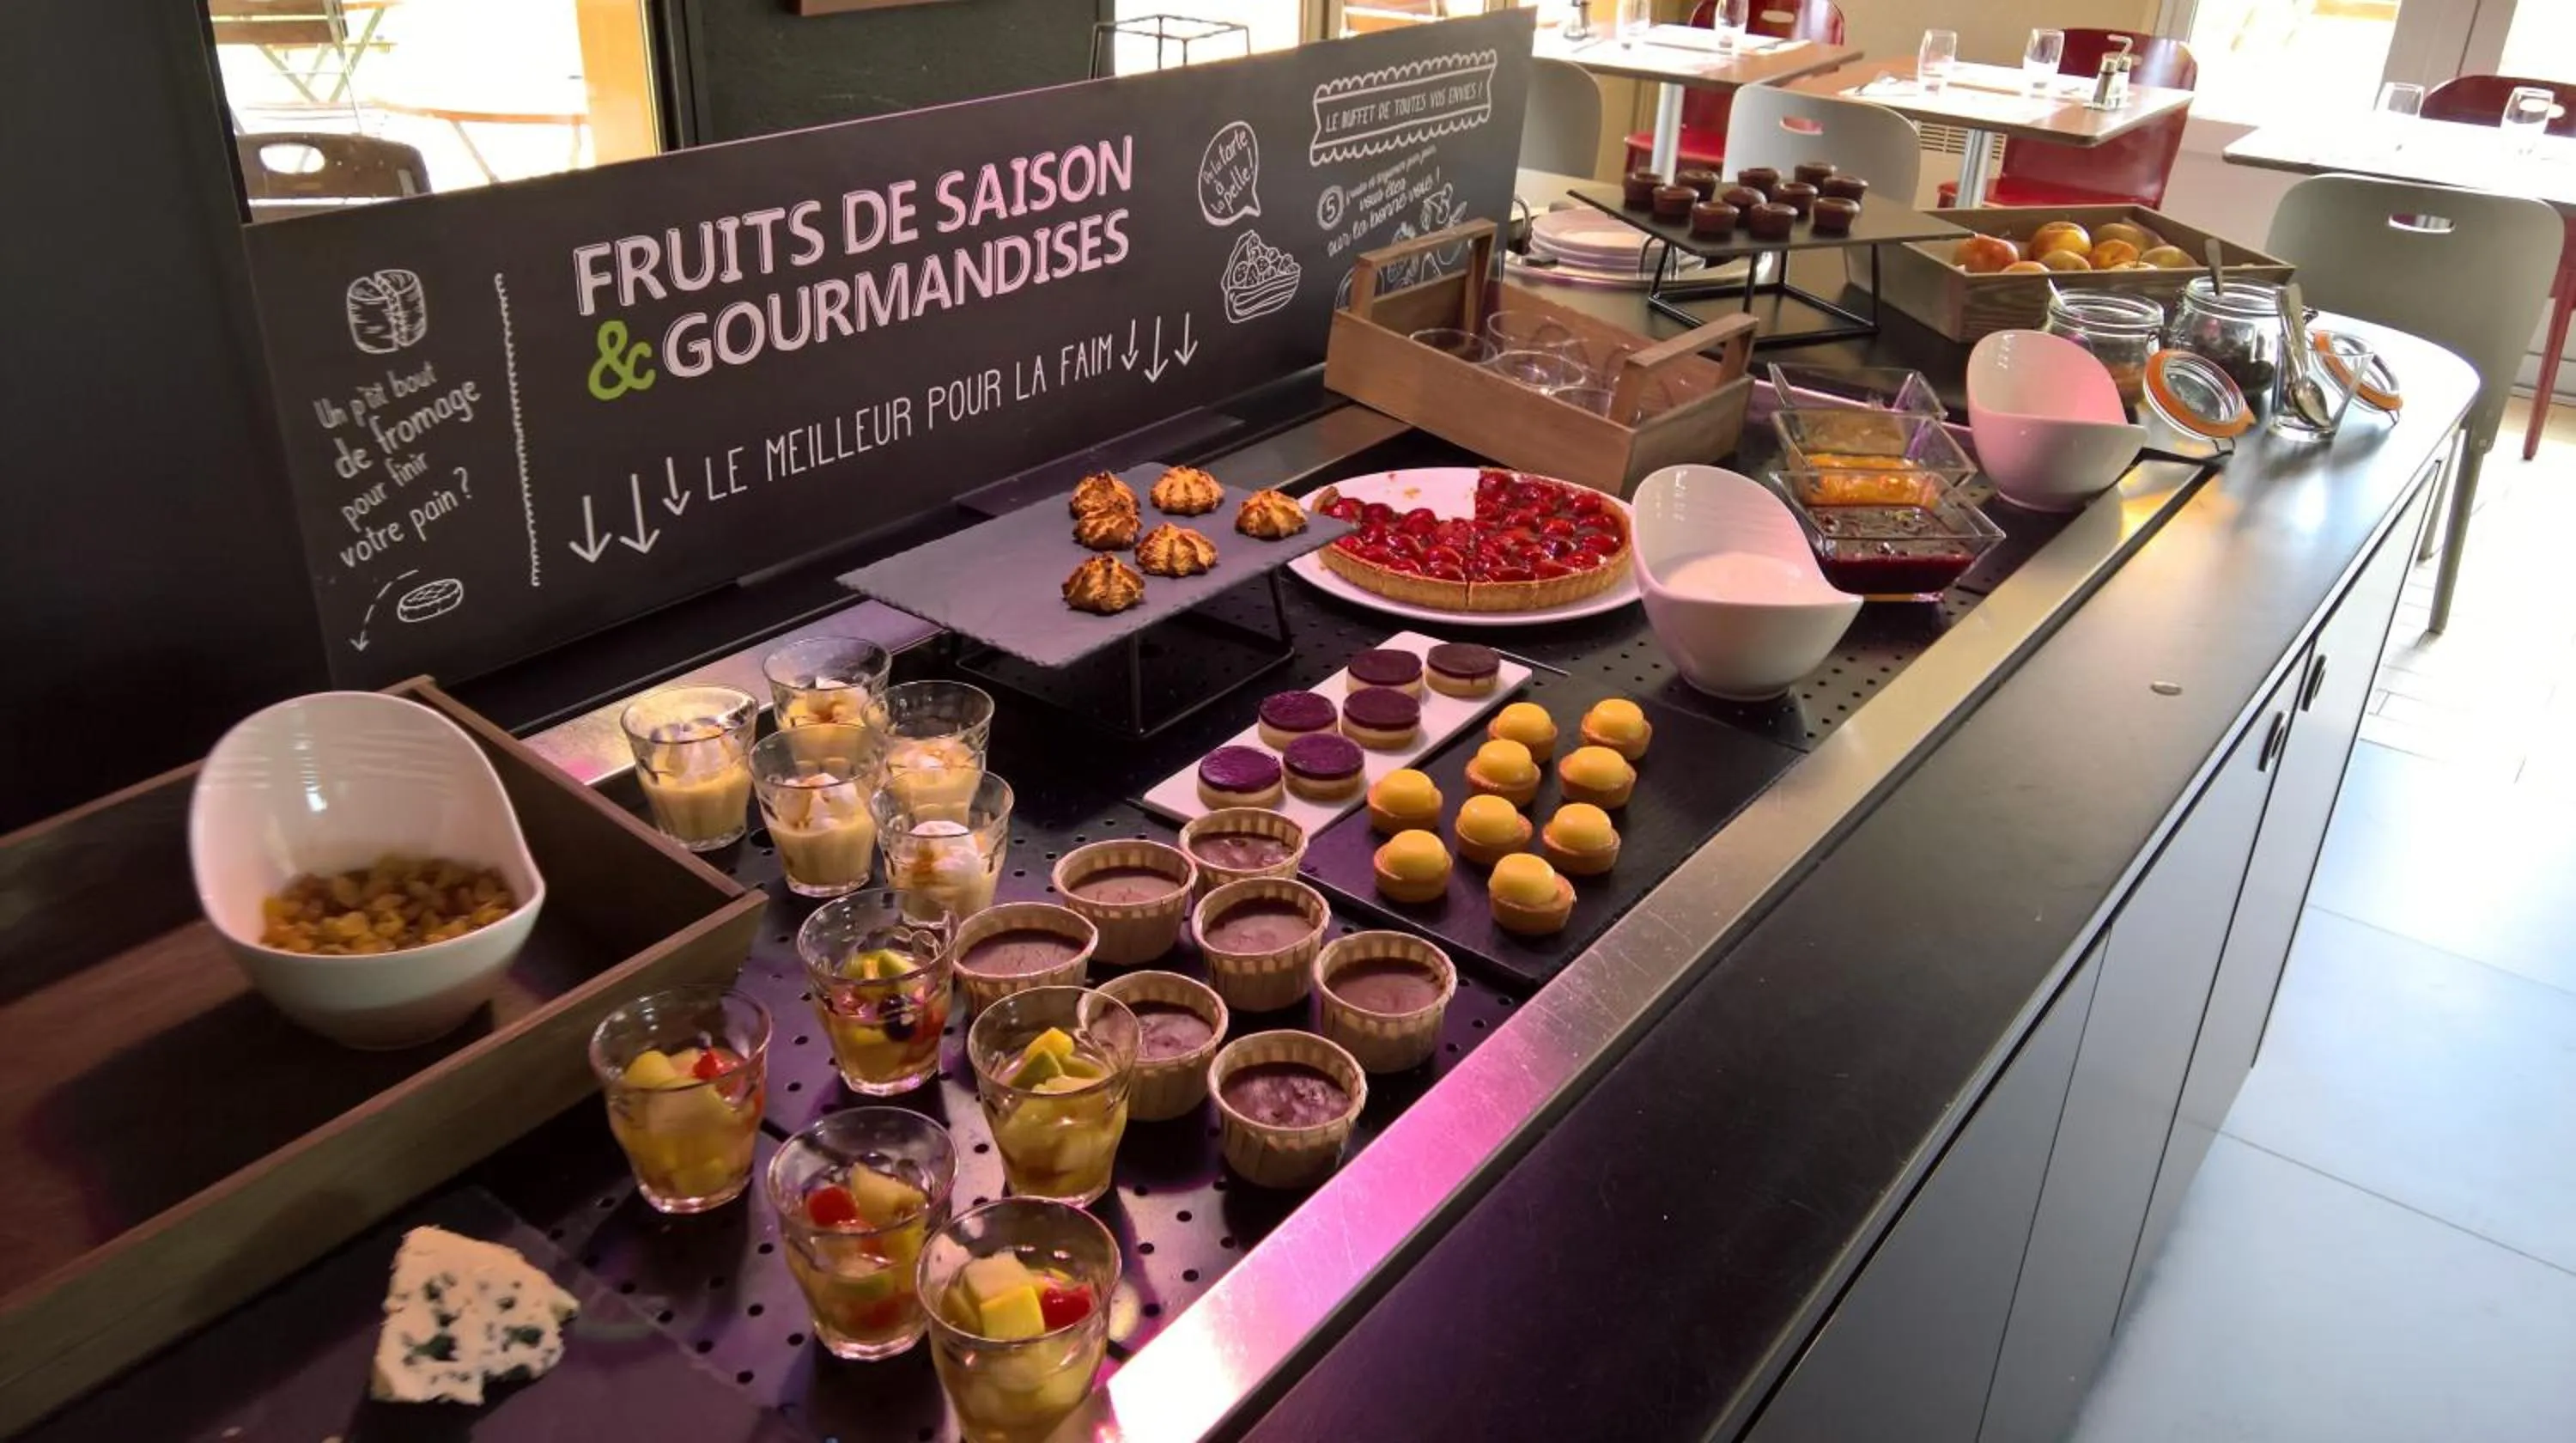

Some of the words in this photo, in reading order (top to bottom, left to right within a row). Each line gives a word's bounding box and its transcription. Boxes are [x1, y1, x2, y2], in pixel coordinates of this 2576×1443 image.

[1218, 130, 1248, 166] tarte
[1325, 111, 1339, 133] LE
[1341, 104, 1375, 129] BUFFET
[1378, 100, 1391, 120] DE
[1394, 93, 1427, 115] TOUTES
[1430, 90, 1445, 109] VOS
[573, 199, 825, 316] FRUITS
[842, 179, 920, 256] DE
[936, 135, 1133, 234] SAISON
[587, 320, 656, 400] &
[662, 209, 1130, 378] GOURMANDISES
[313, 398, 349, 429] Un
[386, 361, 437, 398] bout
[333, 436, 374, 479] de
[368, 381, 482, 454] fromage
[706, 447, 748, 502] LE
[766, 397, 913, 482] MEILLEUR
[927, 369, 1001, 429] POUR
[1015, 355, 1047, 402] LA
[1060, 333, 1113, 386] FAIM
[340, 522, 405, 568] votre
[409, 490, 459, 542] pain
[342, 482, 387, 533] pour
[384, 453, 428, 487] finir
